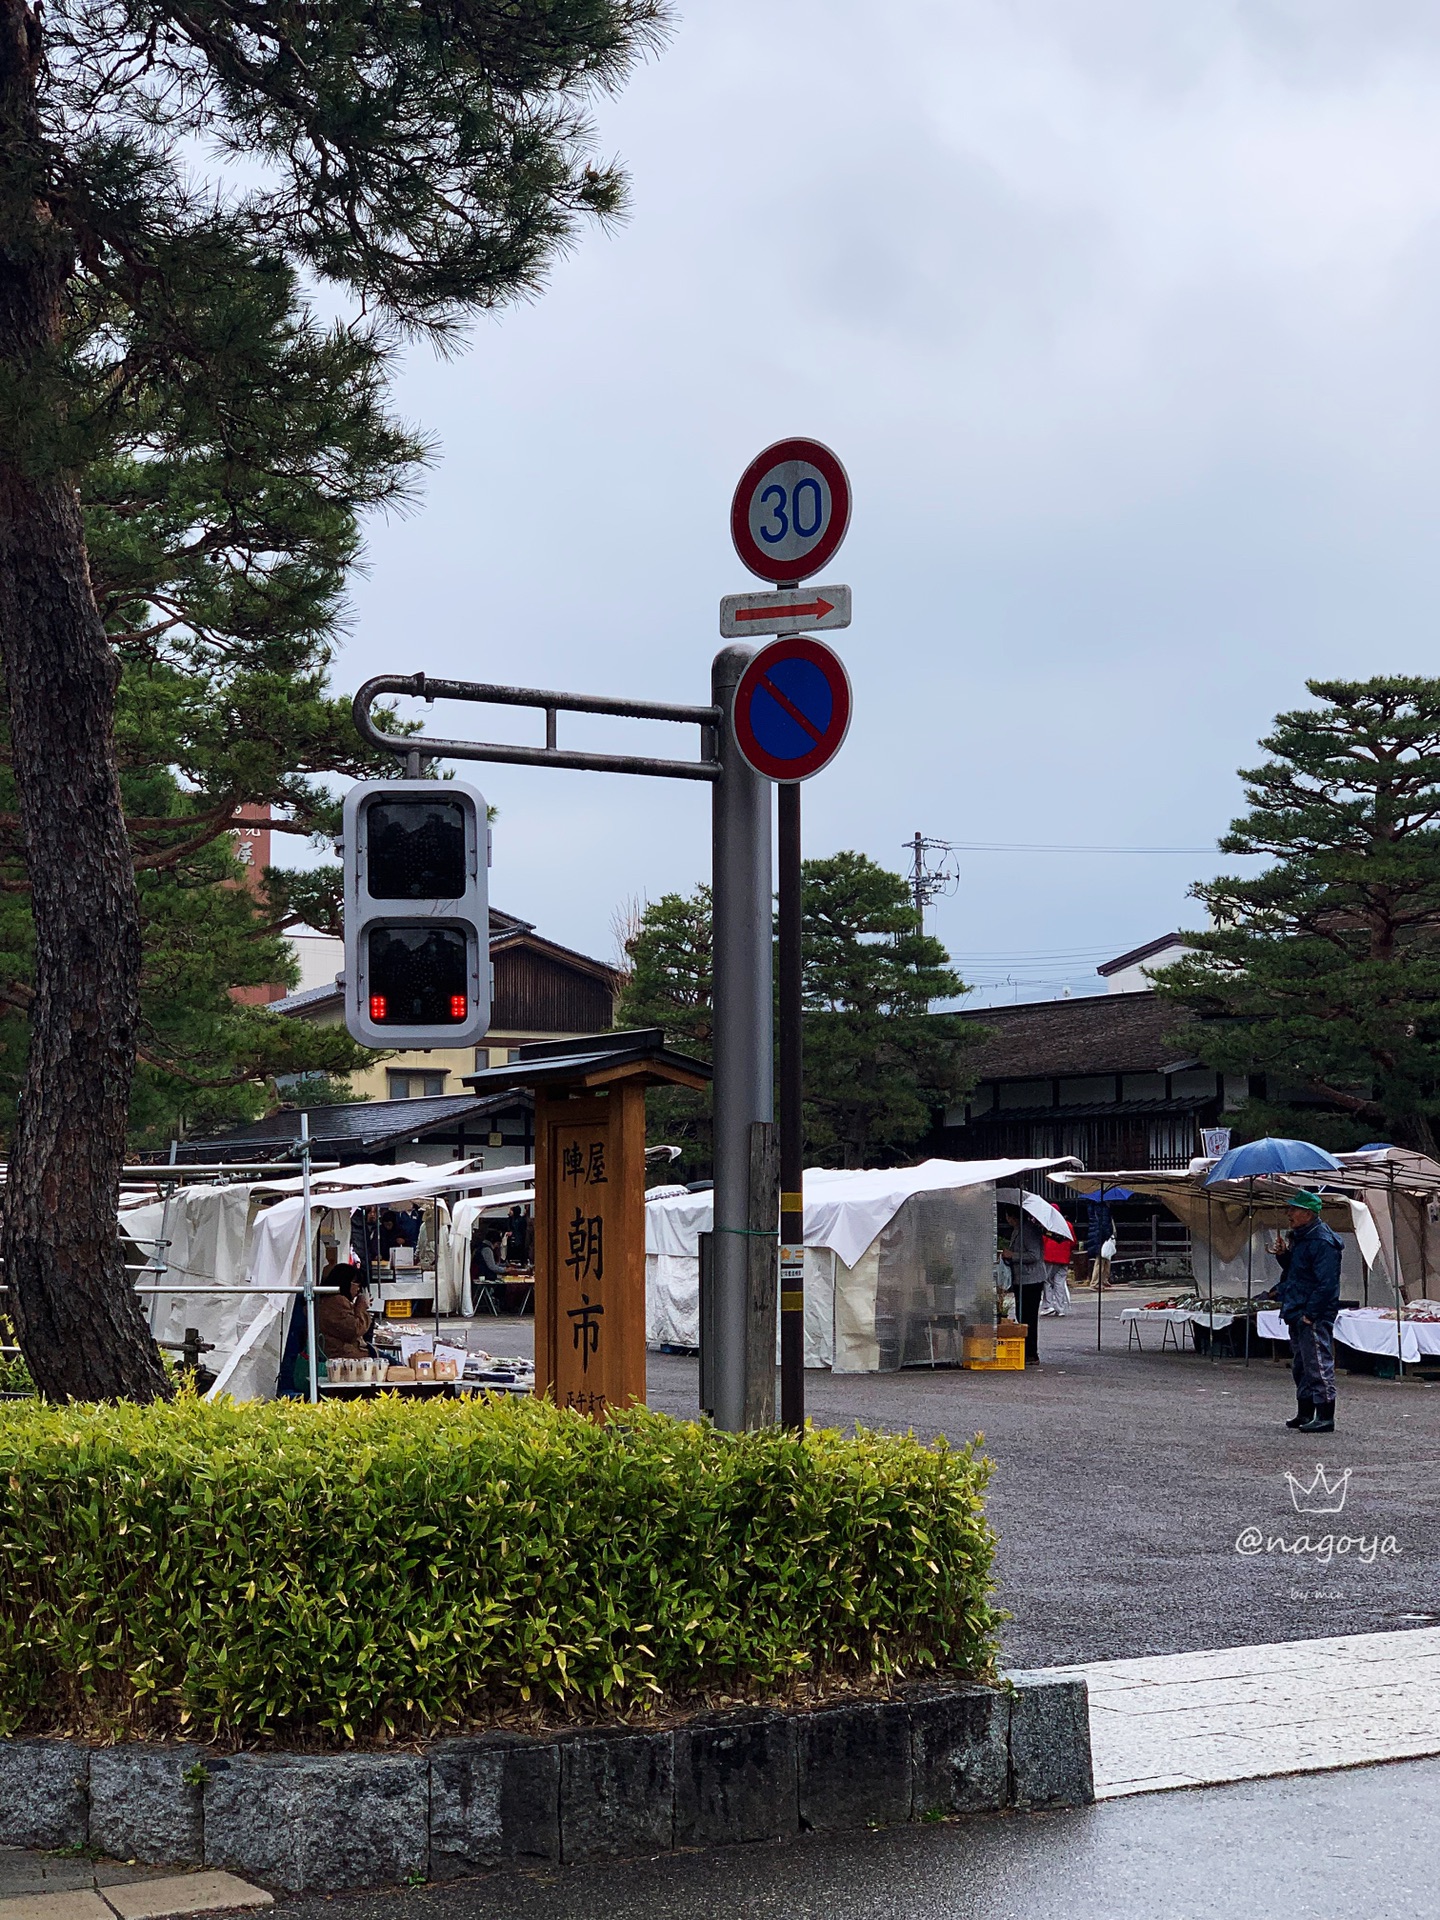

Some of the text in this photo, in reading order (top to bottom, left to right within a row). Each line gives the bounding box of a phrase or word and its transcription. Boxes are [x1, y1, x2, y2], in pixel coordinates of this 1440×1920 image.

[760, 477, 823, 544] 30
[562, 1141, 609, 1188] 陣屋
[564, 1207, 605, 1374] 朝市
